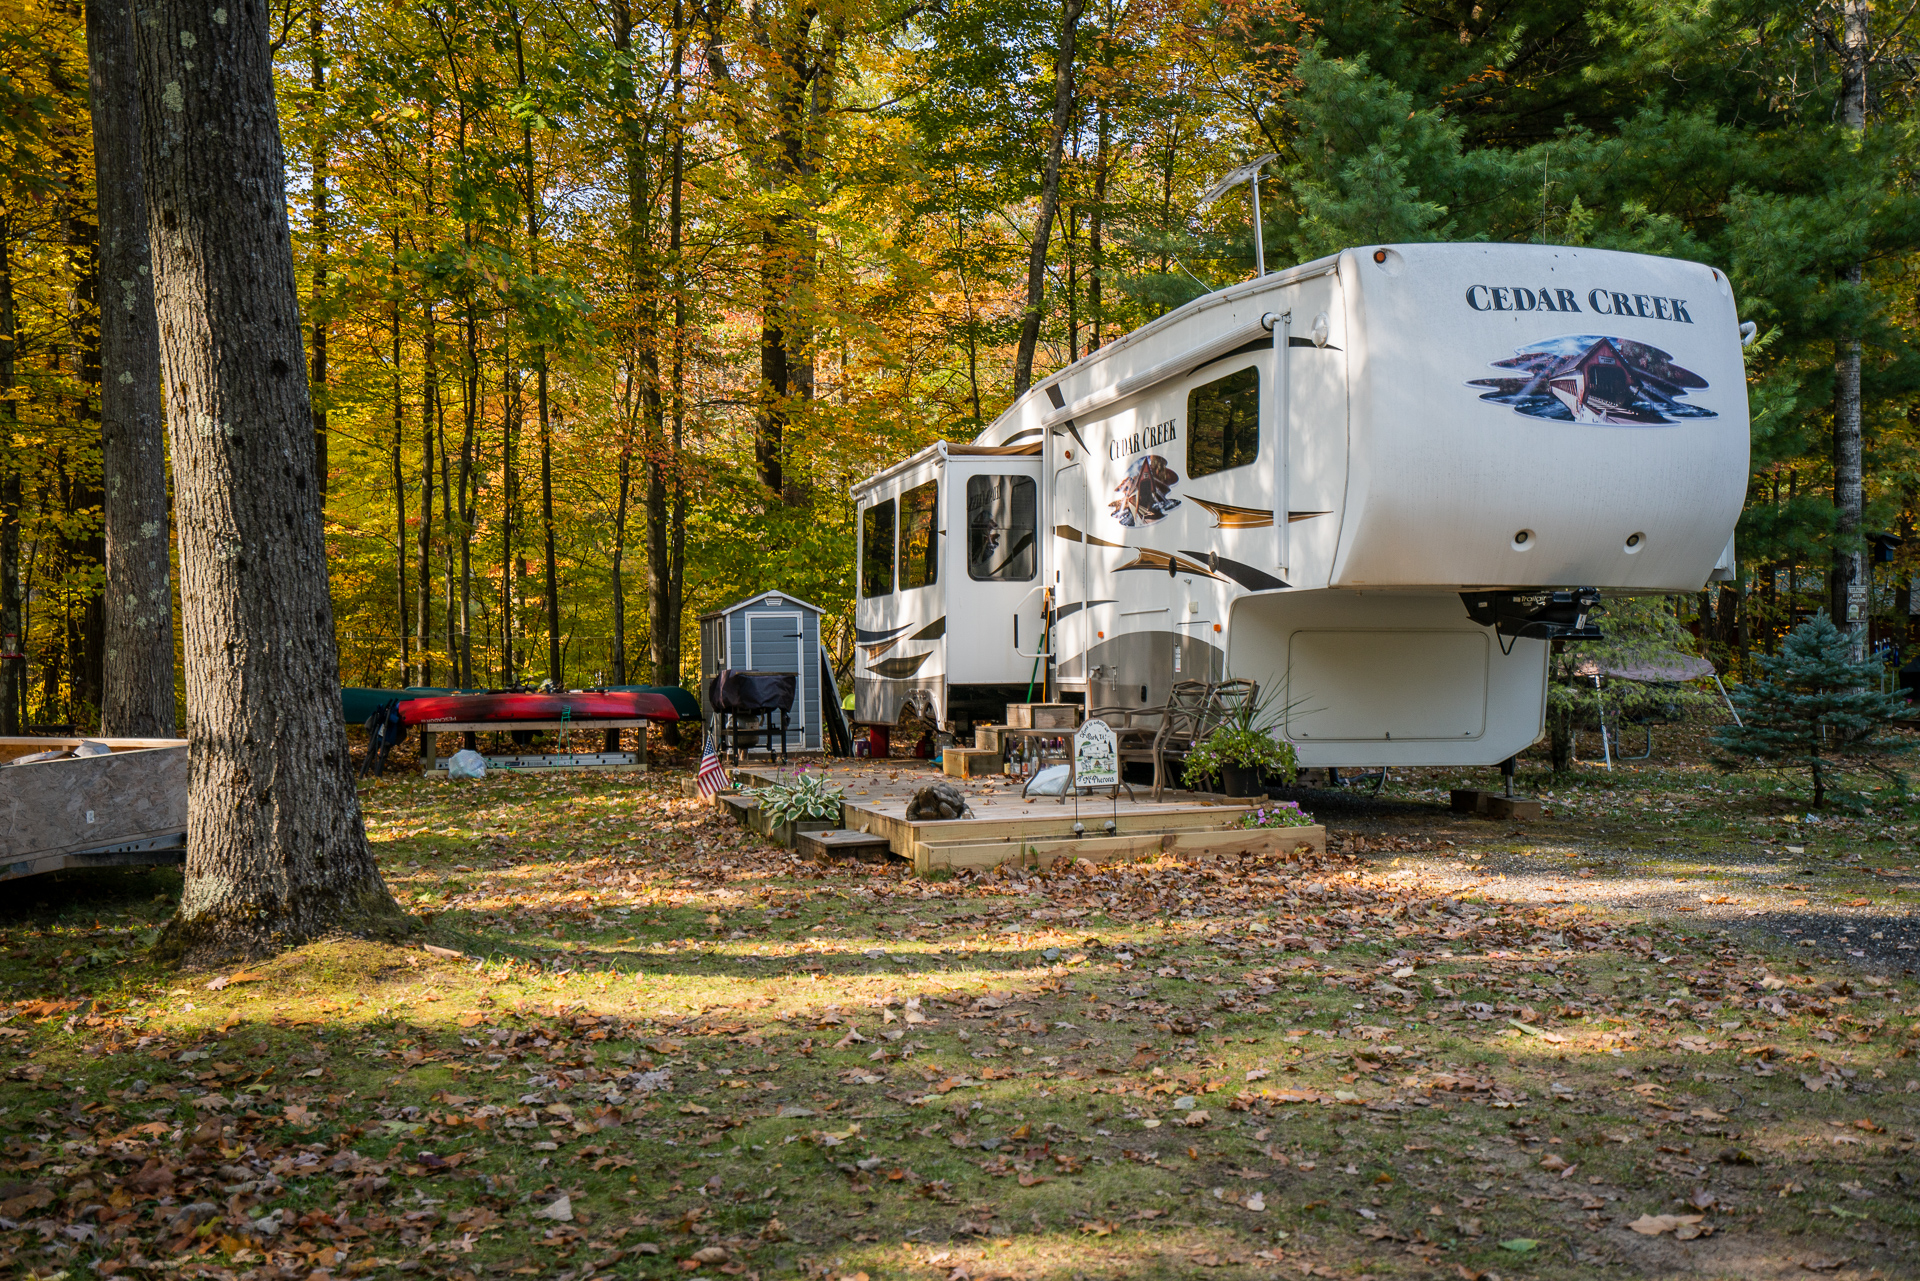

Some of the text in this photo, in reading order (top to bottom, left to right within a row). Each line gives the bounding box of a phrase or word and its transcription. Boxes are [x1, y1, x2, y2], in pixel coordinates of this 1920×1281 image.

[1465, 284, 1694, 324] CEDAR CREEK
[1109, 418, 1177, 461] CEDAR CREEK
